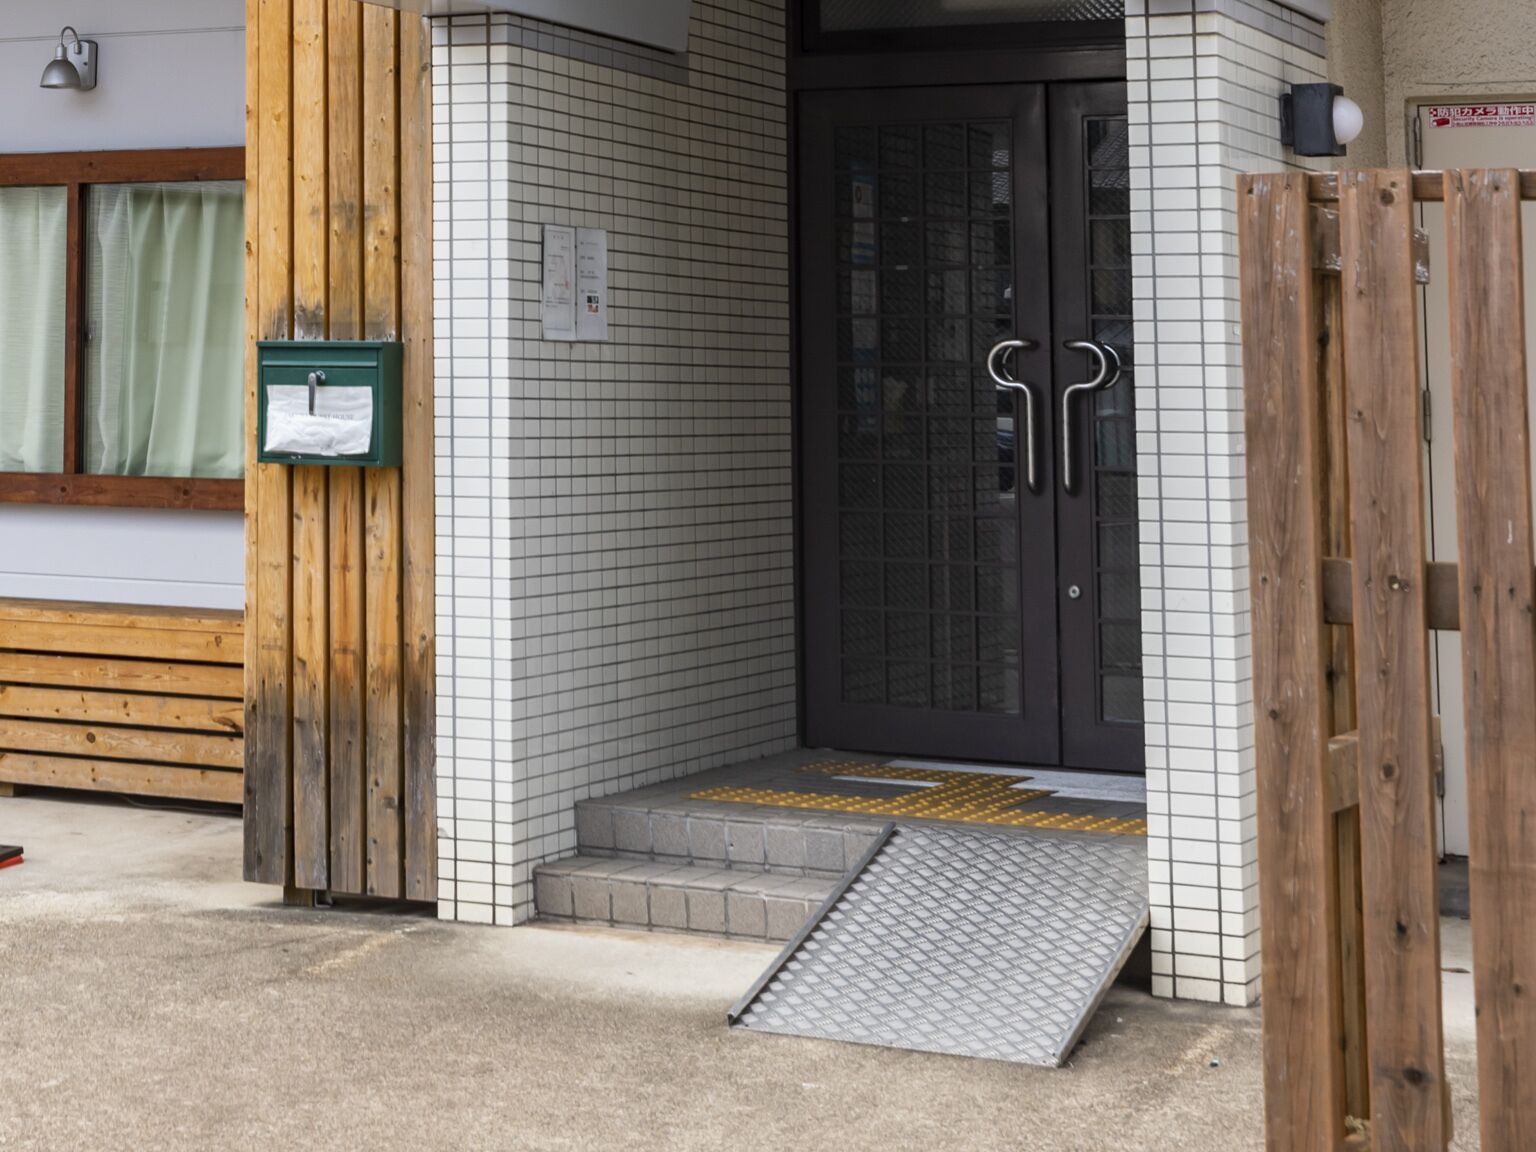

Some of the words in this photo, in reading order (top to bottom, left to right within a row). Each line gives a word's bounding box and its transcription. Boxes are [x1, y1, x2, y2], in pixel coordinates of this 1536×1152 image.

[1438, 105, 1534, 117] 防犯カメラ動作中
